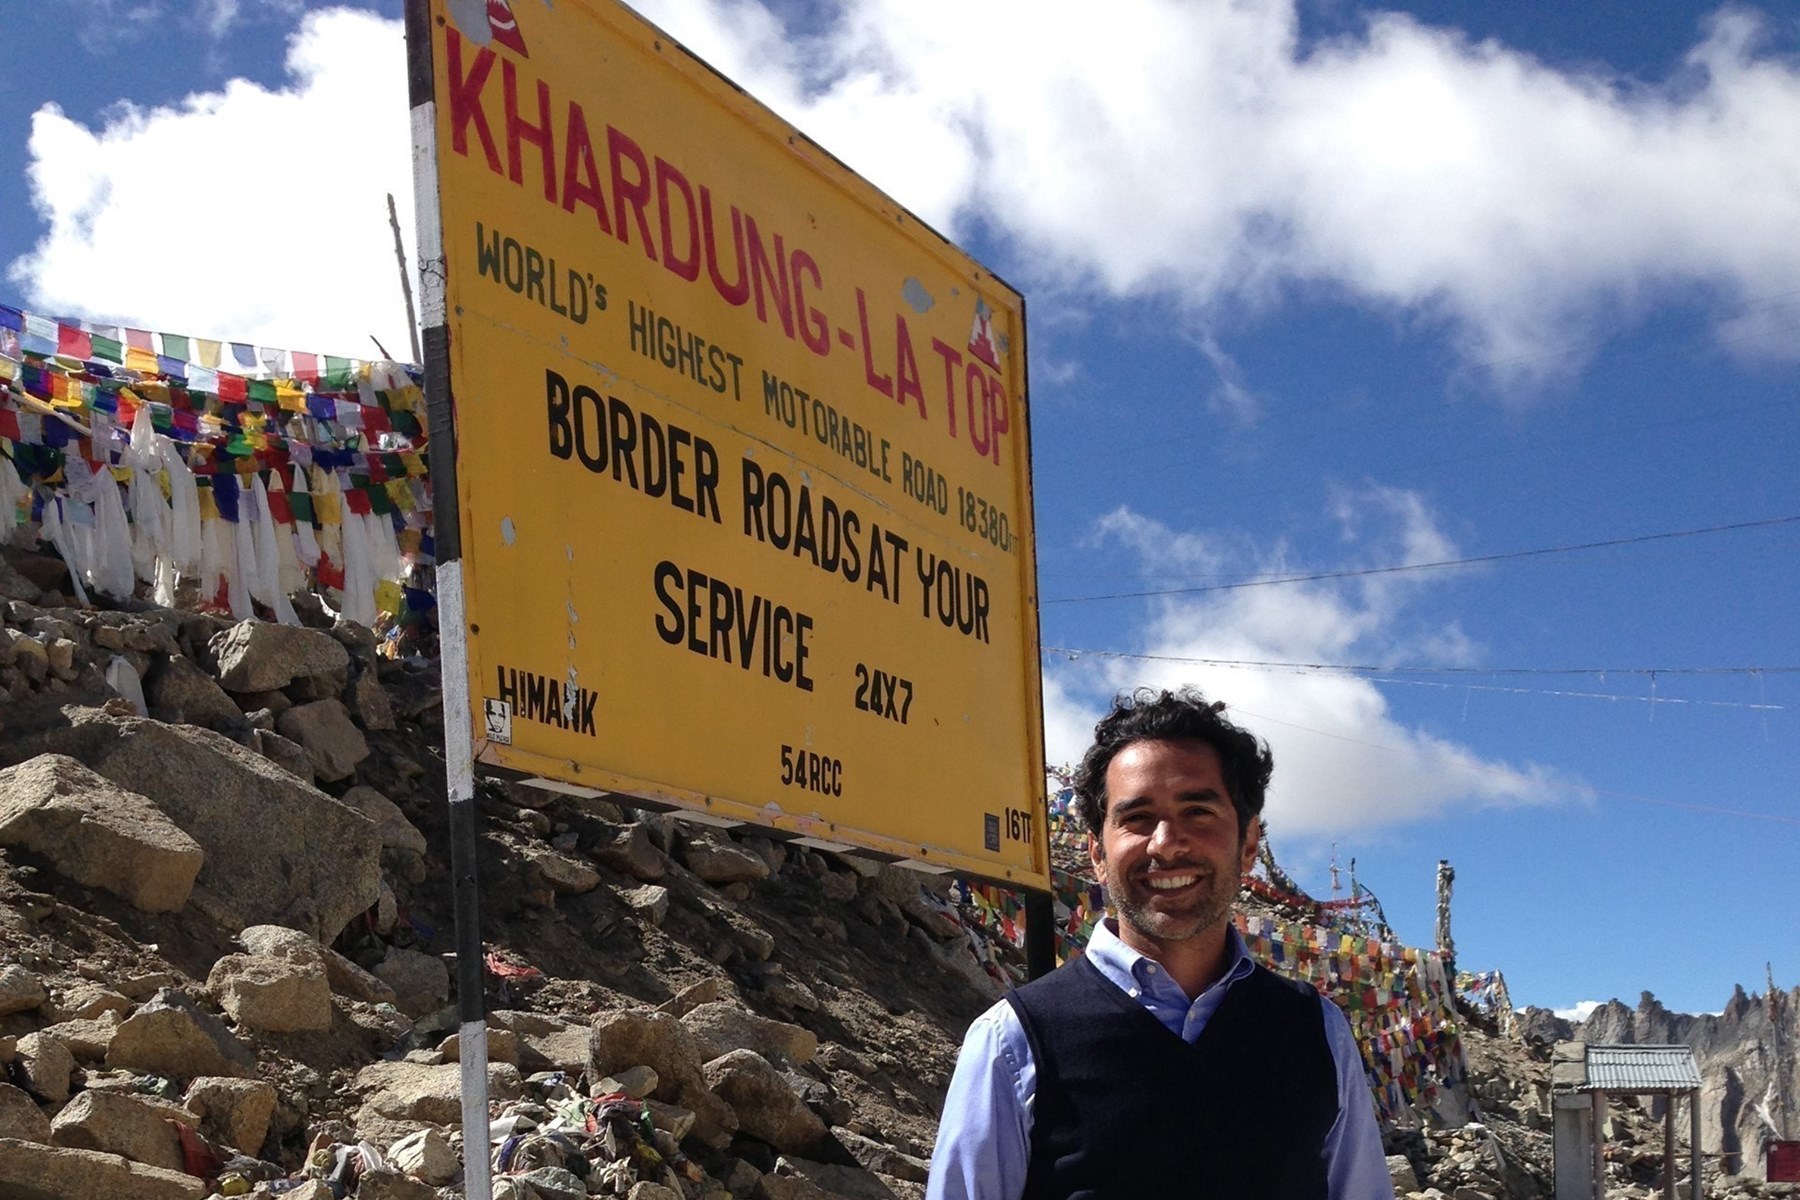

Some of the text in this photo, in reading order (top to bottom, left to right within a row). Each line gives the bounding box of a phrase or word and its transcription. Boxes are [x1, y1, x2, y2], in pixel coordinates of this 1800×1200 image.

[628, 301, 744, 401] HIGHEST
[761, 369, 893, 485] MOTORABLE
[902, 451, 948, 516] ROAD
[932, 338, 1009, 466] TOP
[545, 368, 990, 644] BORDER ROADS AT YOUR
[654, 560, 814, 692] SERVICE
[854, 663, 914, 726] 24X7
